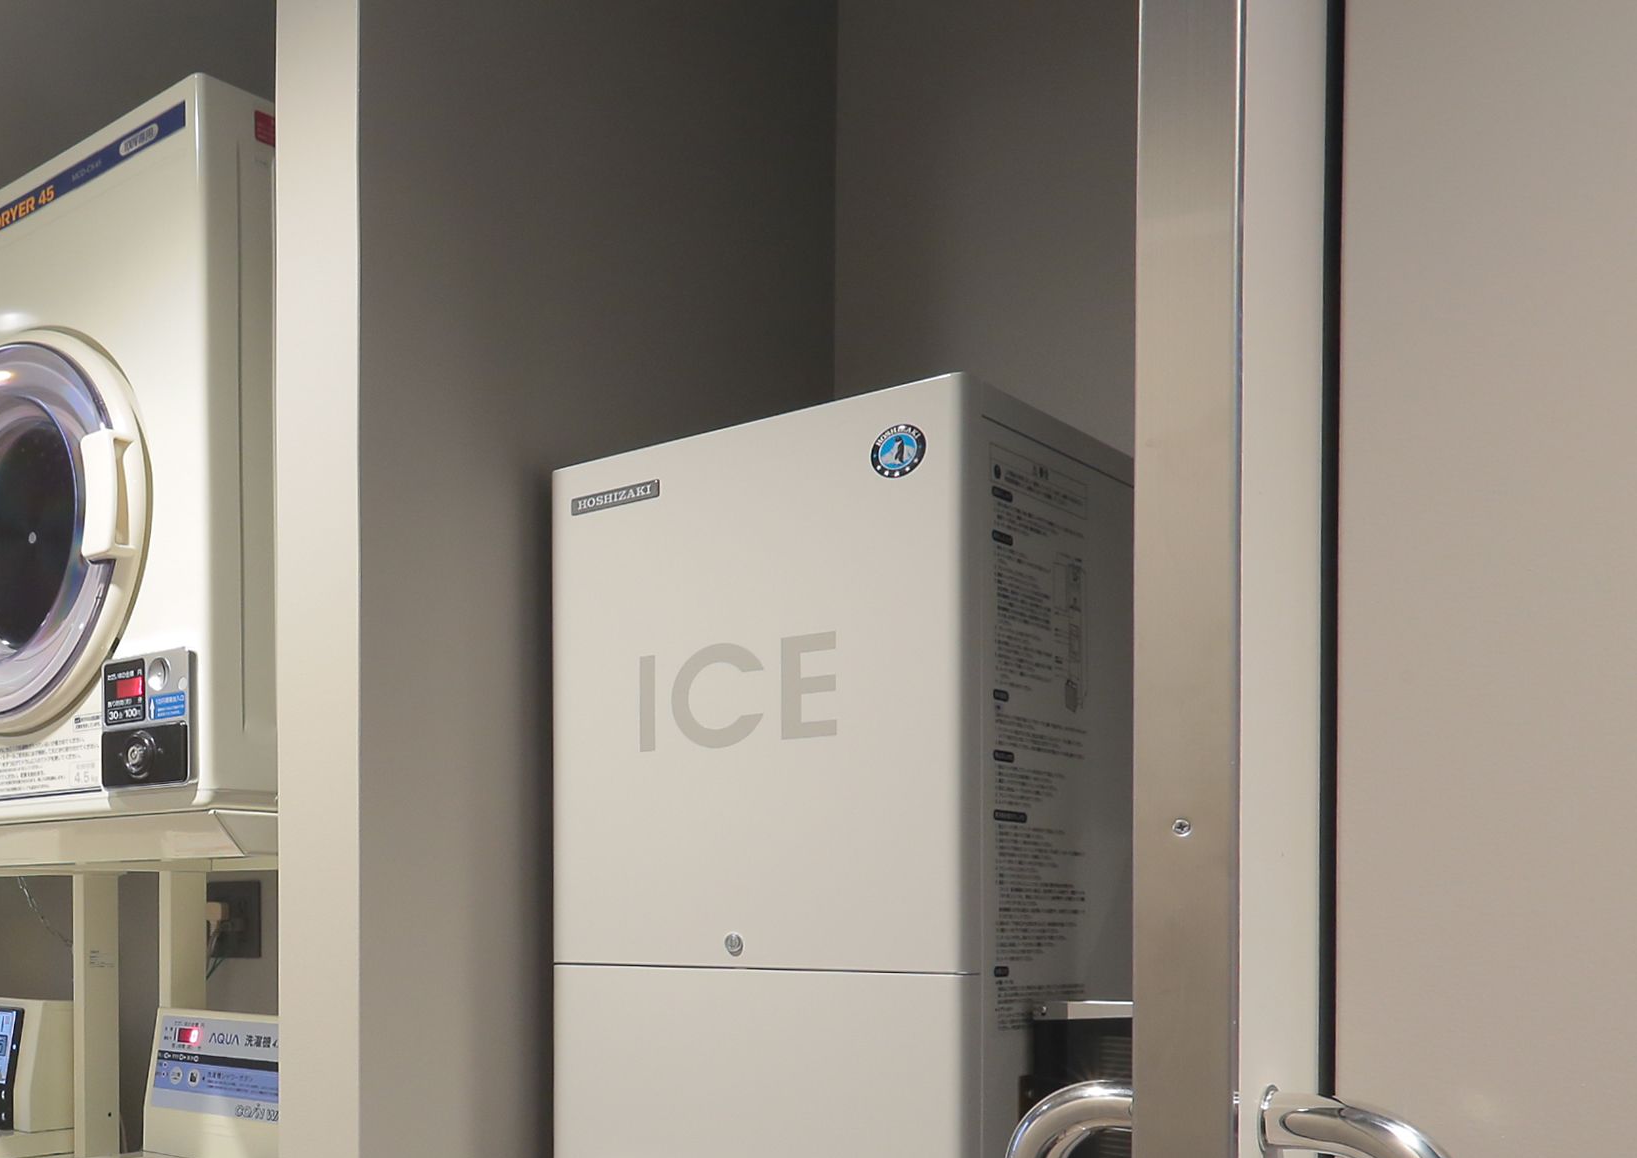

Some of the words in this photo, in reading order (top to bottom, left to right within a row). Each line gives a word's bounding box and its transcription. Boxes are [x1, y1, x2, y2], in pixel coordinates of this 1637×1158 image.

[37, 184, 56, 209] 45
[577, 484, 652, 511] HOSHIZAKI
[638, 630, 838, 753] ICE
[209, 1032, 240, 1046] AQUA
[244, 1034, 272, 1049] 洗濯機
[234, 1103, 266, 1121] COIN
